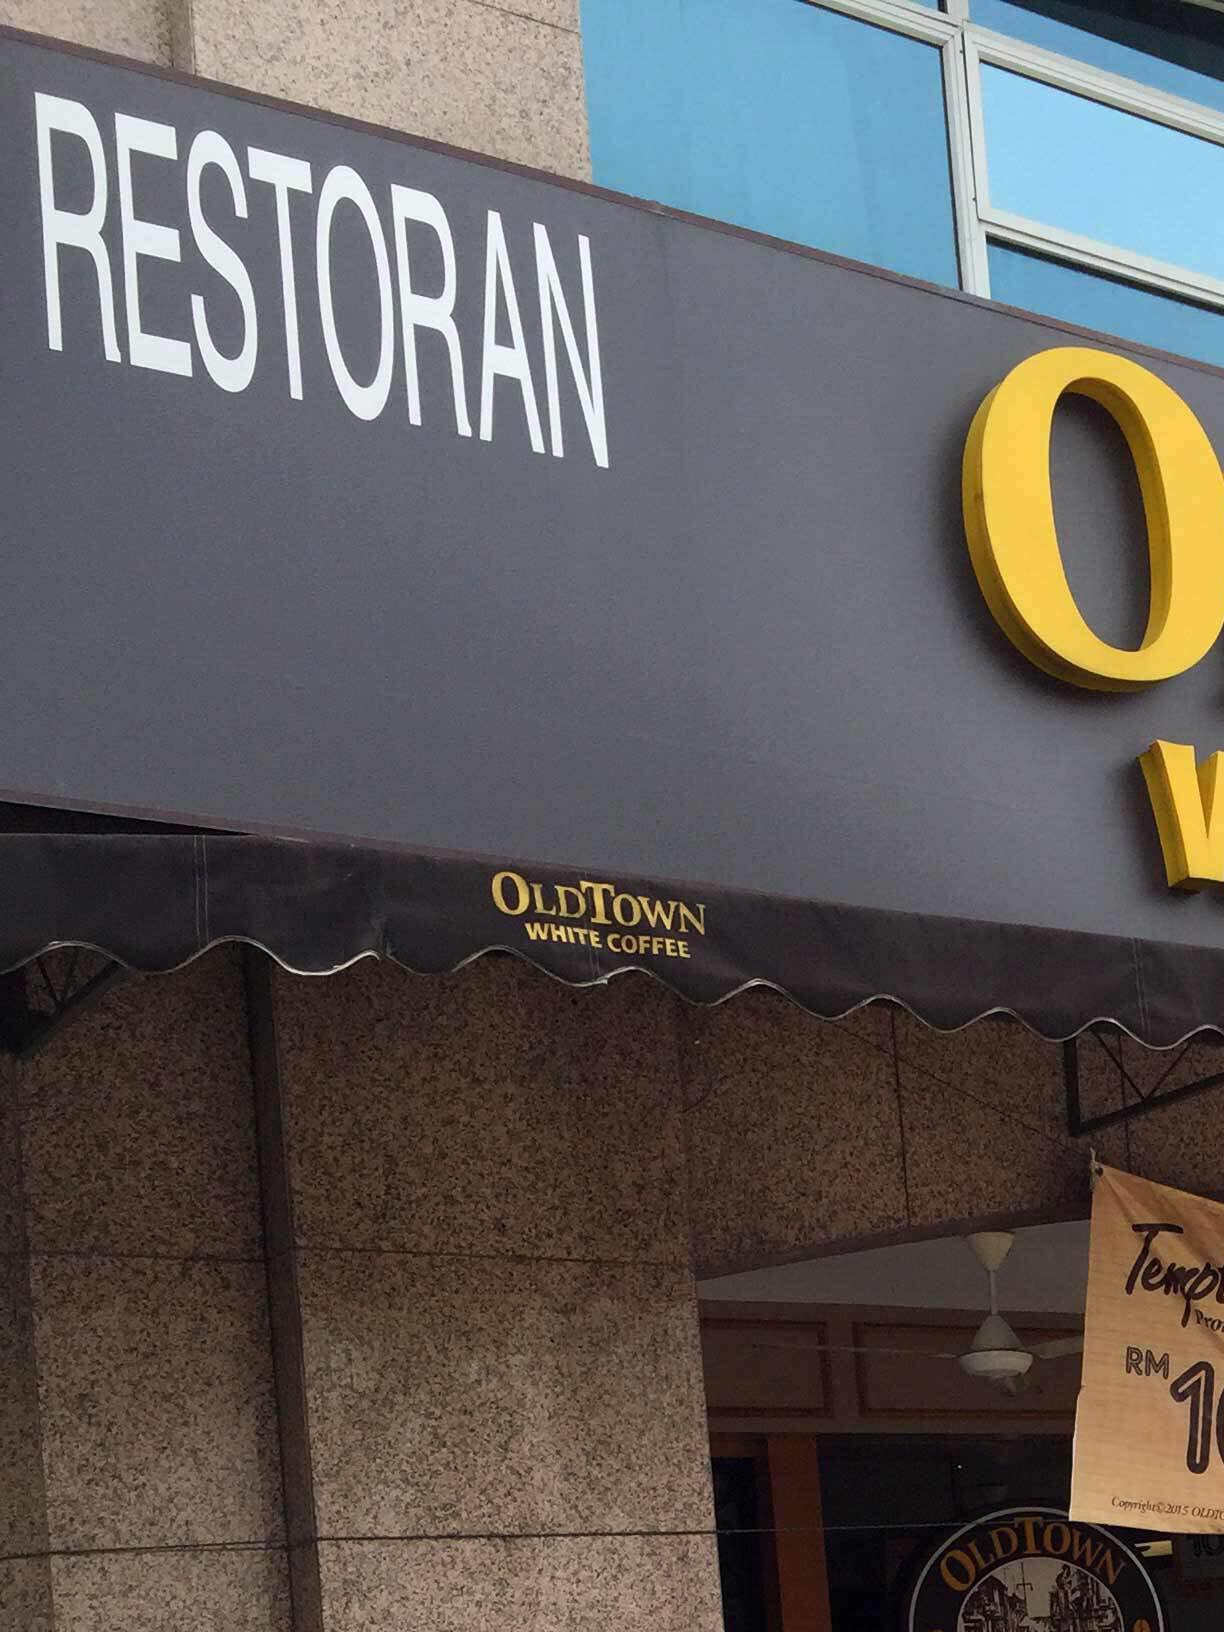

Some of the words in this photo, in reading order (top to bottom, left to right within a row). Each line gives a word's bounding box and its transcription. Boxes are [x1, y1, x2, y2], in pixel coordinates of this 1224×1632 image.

[35, 92, 608, 468] RESTORAN
[492, 871, 706, 936] OLDTOWN
[525, 922, 602, 948] WHITE
[607, 932, 692, 958] COFFEE
[1125, 1346, 1170, 1380] RM
[939, 1516, 1126, 1592] OLDTOWN
